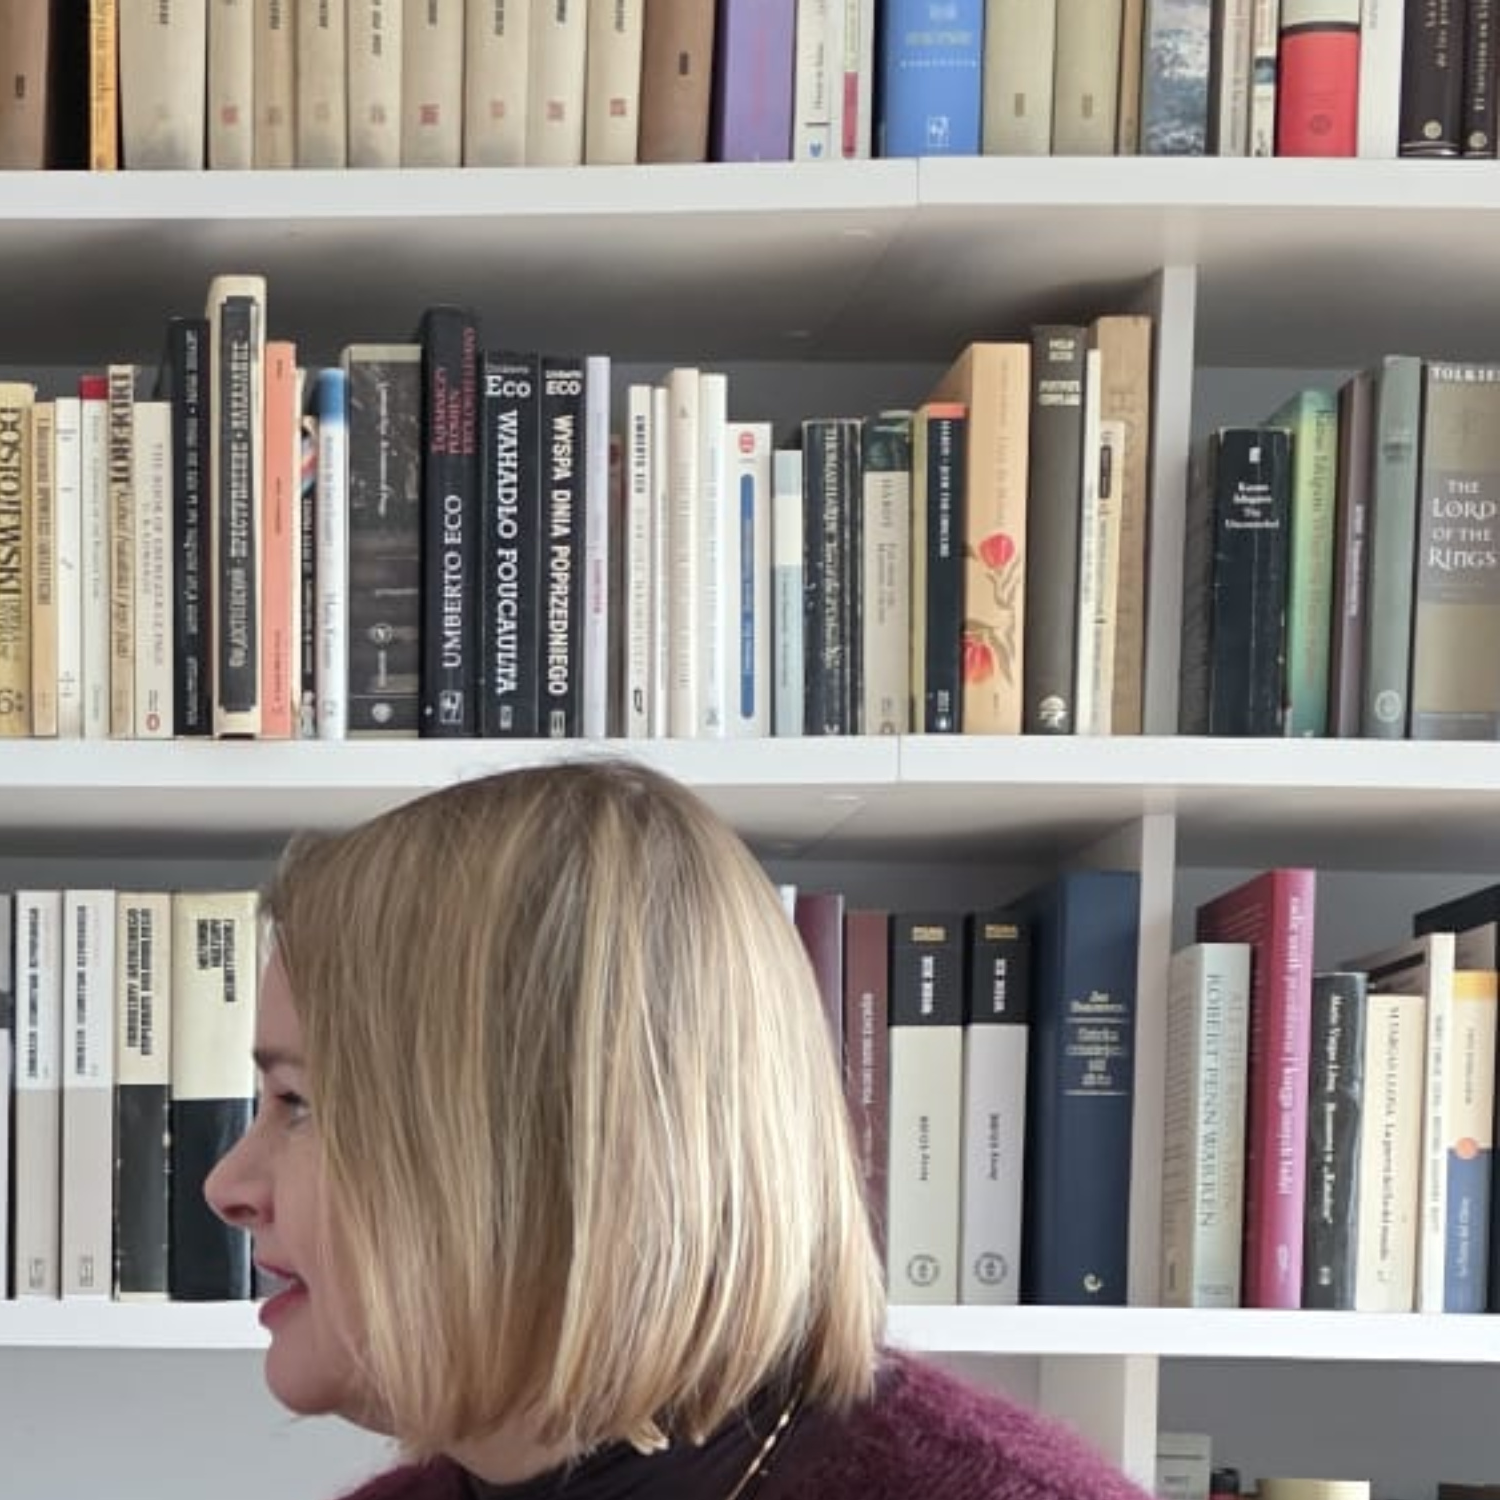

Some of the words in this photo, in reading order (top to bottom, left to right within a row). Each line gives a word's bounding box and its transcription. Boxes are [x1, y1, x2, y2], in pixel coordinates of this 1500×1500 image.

[545, 381, 582, 396] ECO
[109, 374, 131, 483] DIDEROT
[551, 415, 574, 481] WYSPA
[497, 409, 518, 540] WAHADŁO
[1448, 480, 1479, 494] THE
[444, 495, 462, 544] ECO
[550, 489, 572, 537] DNIA
[1431, 498, 1497, 520] LORD
[1432, 528, 1456, 541] OF
[1460, 528, 1492, 542] THE
[1428, 549, 1497, 571] RINGS
[442, 551, 462, 668] UMBERTO
[495, 547, 518, 695] FOUCAULTA
[547, 543, 571, 696] POPRZEDNIEGO
